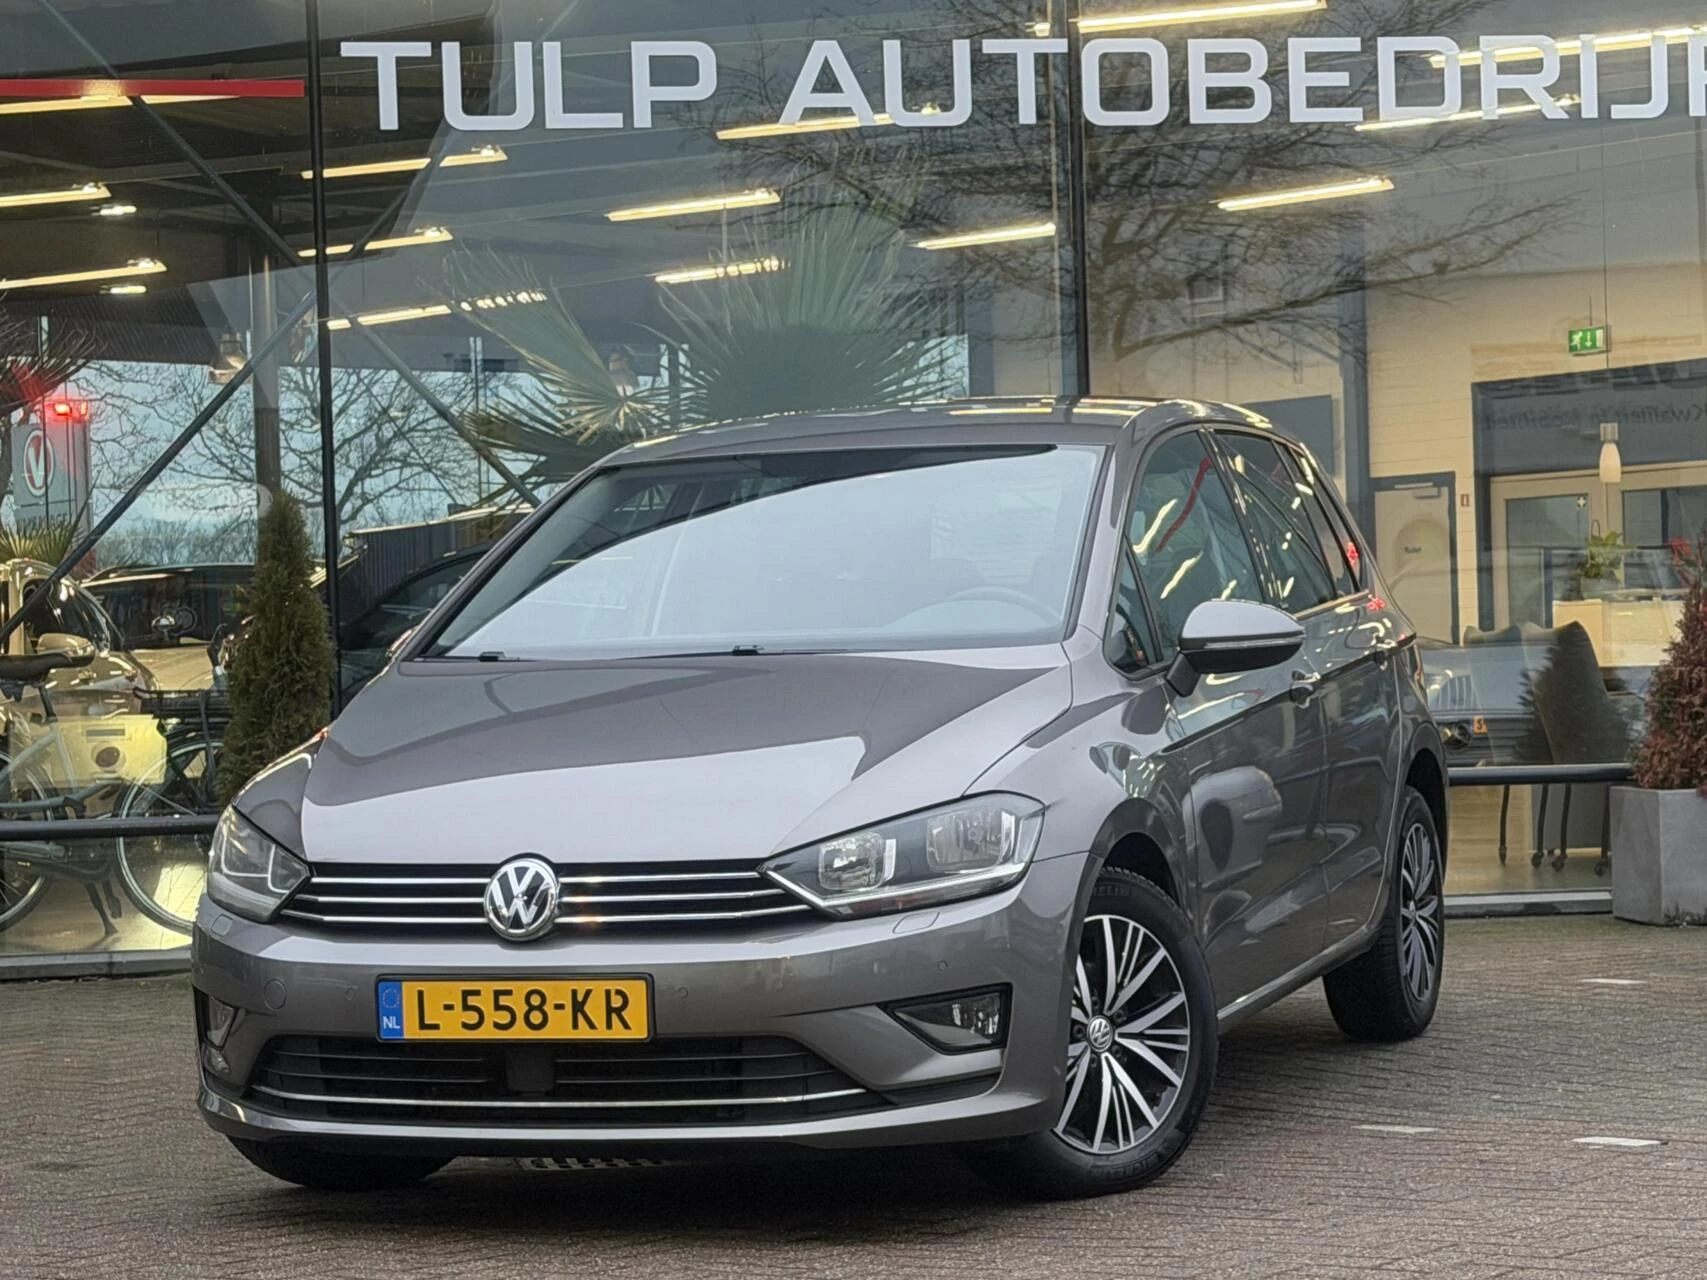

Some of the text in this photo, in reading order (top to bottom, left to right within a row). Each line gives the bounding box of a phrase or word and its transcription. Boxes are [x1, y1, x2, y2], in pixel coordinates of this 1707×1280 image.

[340, 41, 718, 131] TULP
[487, 861, 557, 934] VW
[383, 988, 632, 1031] NL L-558-KR
